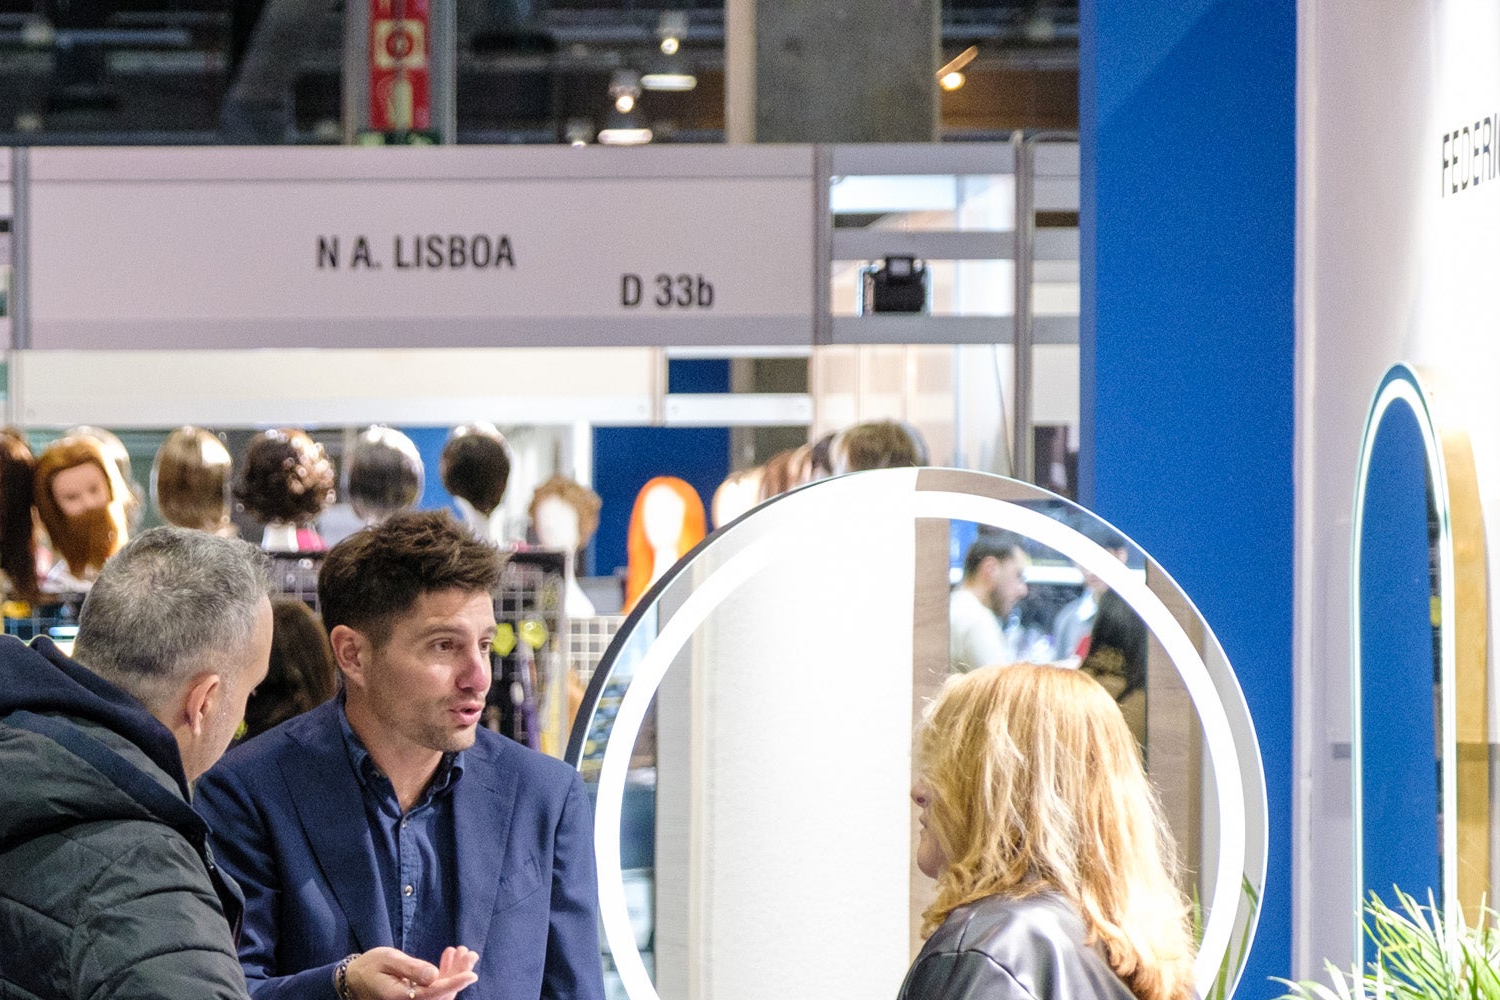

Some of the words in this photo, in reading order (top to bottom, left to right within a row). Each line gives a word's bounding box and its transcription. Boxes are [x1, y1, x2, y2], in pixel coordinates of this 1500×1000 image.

[1441, 113, 1500, 198] FEDERI
[317, 234, 338, 268] N
[396, 234, 515, 268] LISBOA
[621, 274, 642, 306] D
[655, 273, 714, 307] 33b
